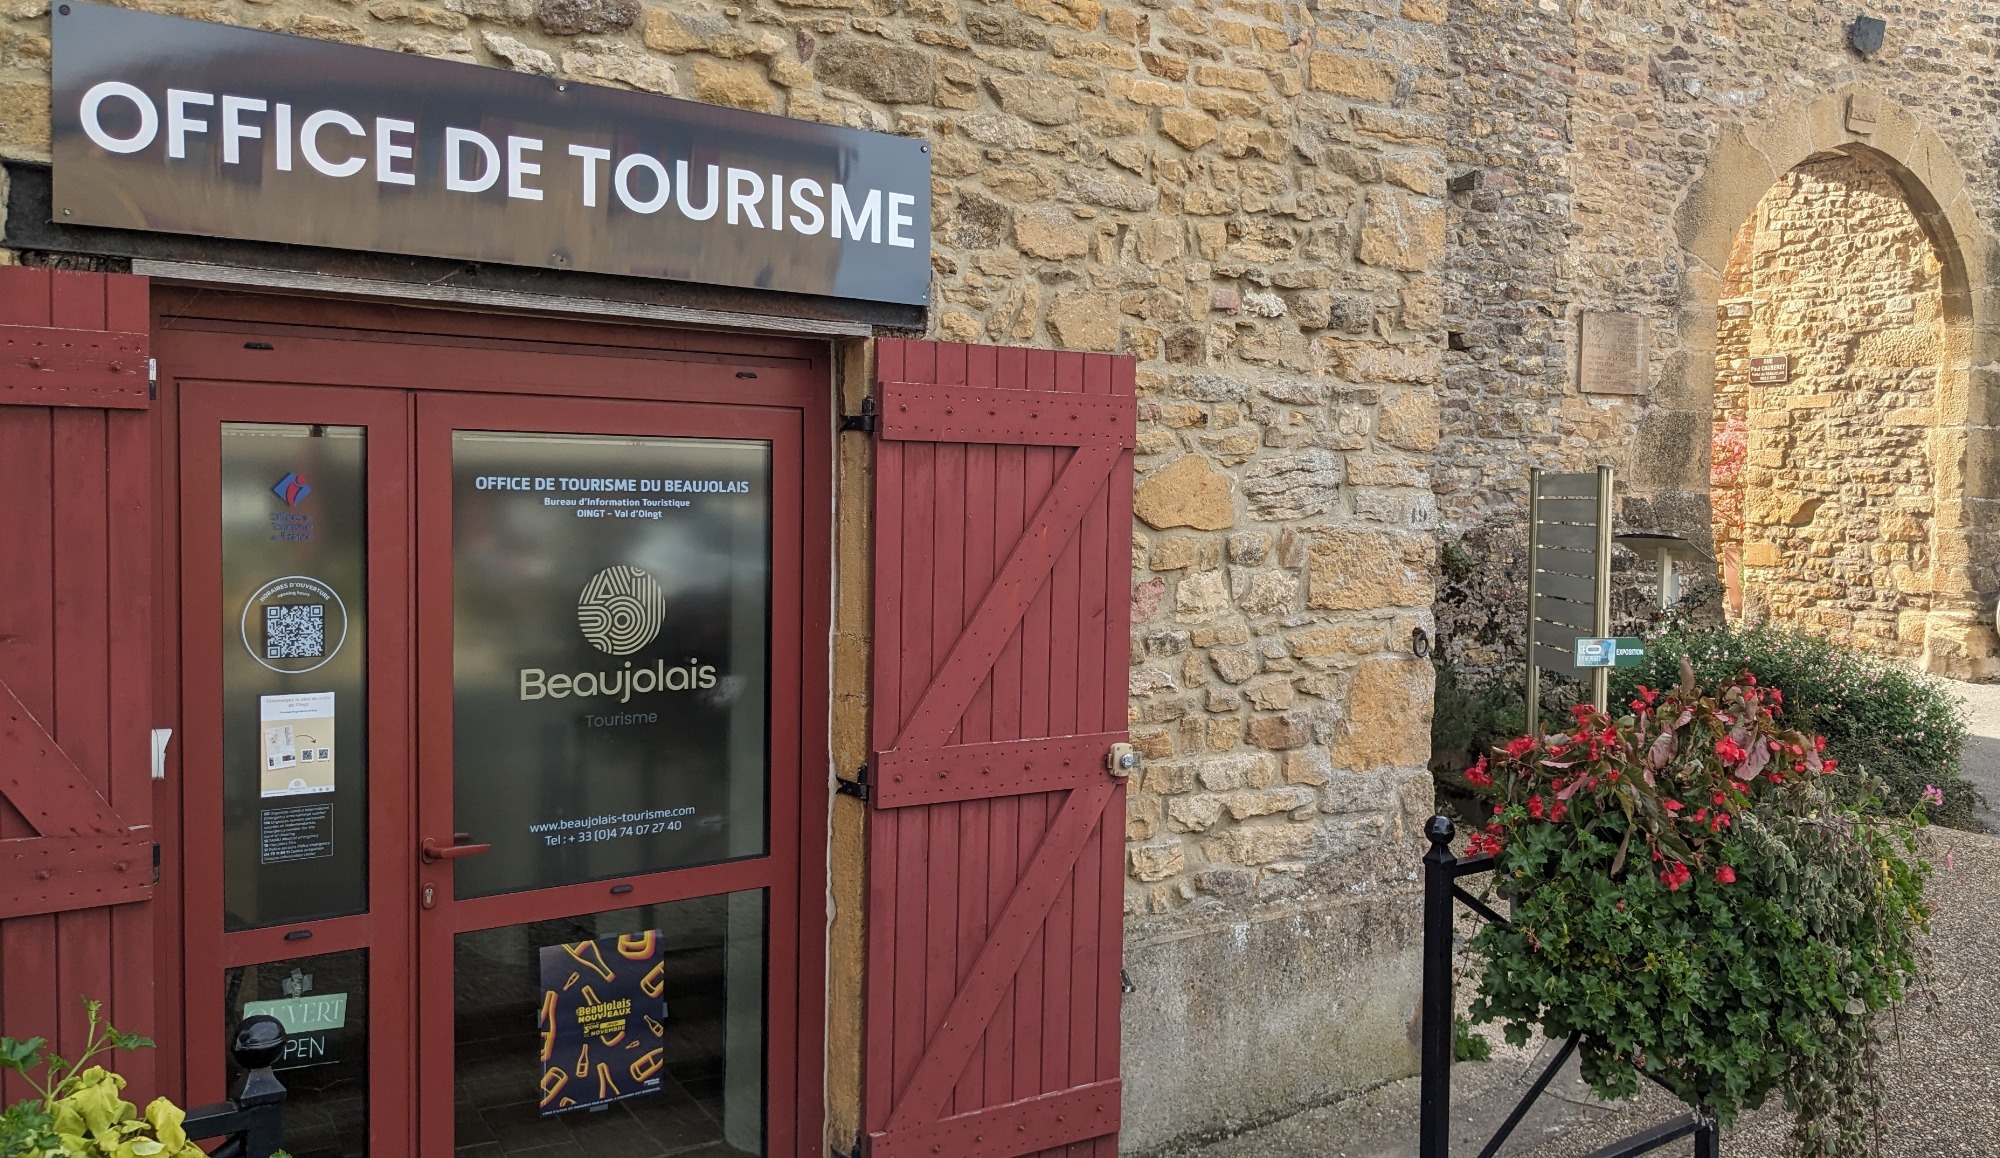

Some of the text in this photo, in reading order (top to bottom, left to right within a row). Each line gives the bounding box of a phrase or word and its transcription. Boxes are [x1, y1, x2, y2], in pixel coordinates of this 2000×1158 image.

[79, 81, 916, 250] OFFICE DE TOURISME
[475, 476, 749, 493] OFFICE DE TOURISME DU BEAUJOLAIS
[544, 497, 691, 508] Bureau d'Information Touristique
[576, 509, 606, 518] OINGT
[614, 509, 629, 518] Val
[260, 582, 331, 602] HORAIRES D'OUVERTURE
[1616, 648, 1643, 656] EXPOSITION
[520, 657, 717, 704] Beaujolais
[585, 711, 658, 728] Tourisme
[529, 806, 696, 833] www.beaujolais-tourisme.com
[545, 834, 561, 846] Tel
[578, 831, 592, 842] 33
[594, 826, 617, 842] (0)4
[620, 826, 633, 837] 74
[636, 824, 650, 835] 07
[652, 822, 665, 833] 27
[667, 820, 682, 831] 40
[247, 999, 344, 1024] VERT
[578, 998, 632, 1018] Beaujolais
[578, 1008, 632, 1024] NOUVEAUX
[591, 1025, 626, 1036] NOVEMBRE
[283, 1035, 325, 1060] PEN
